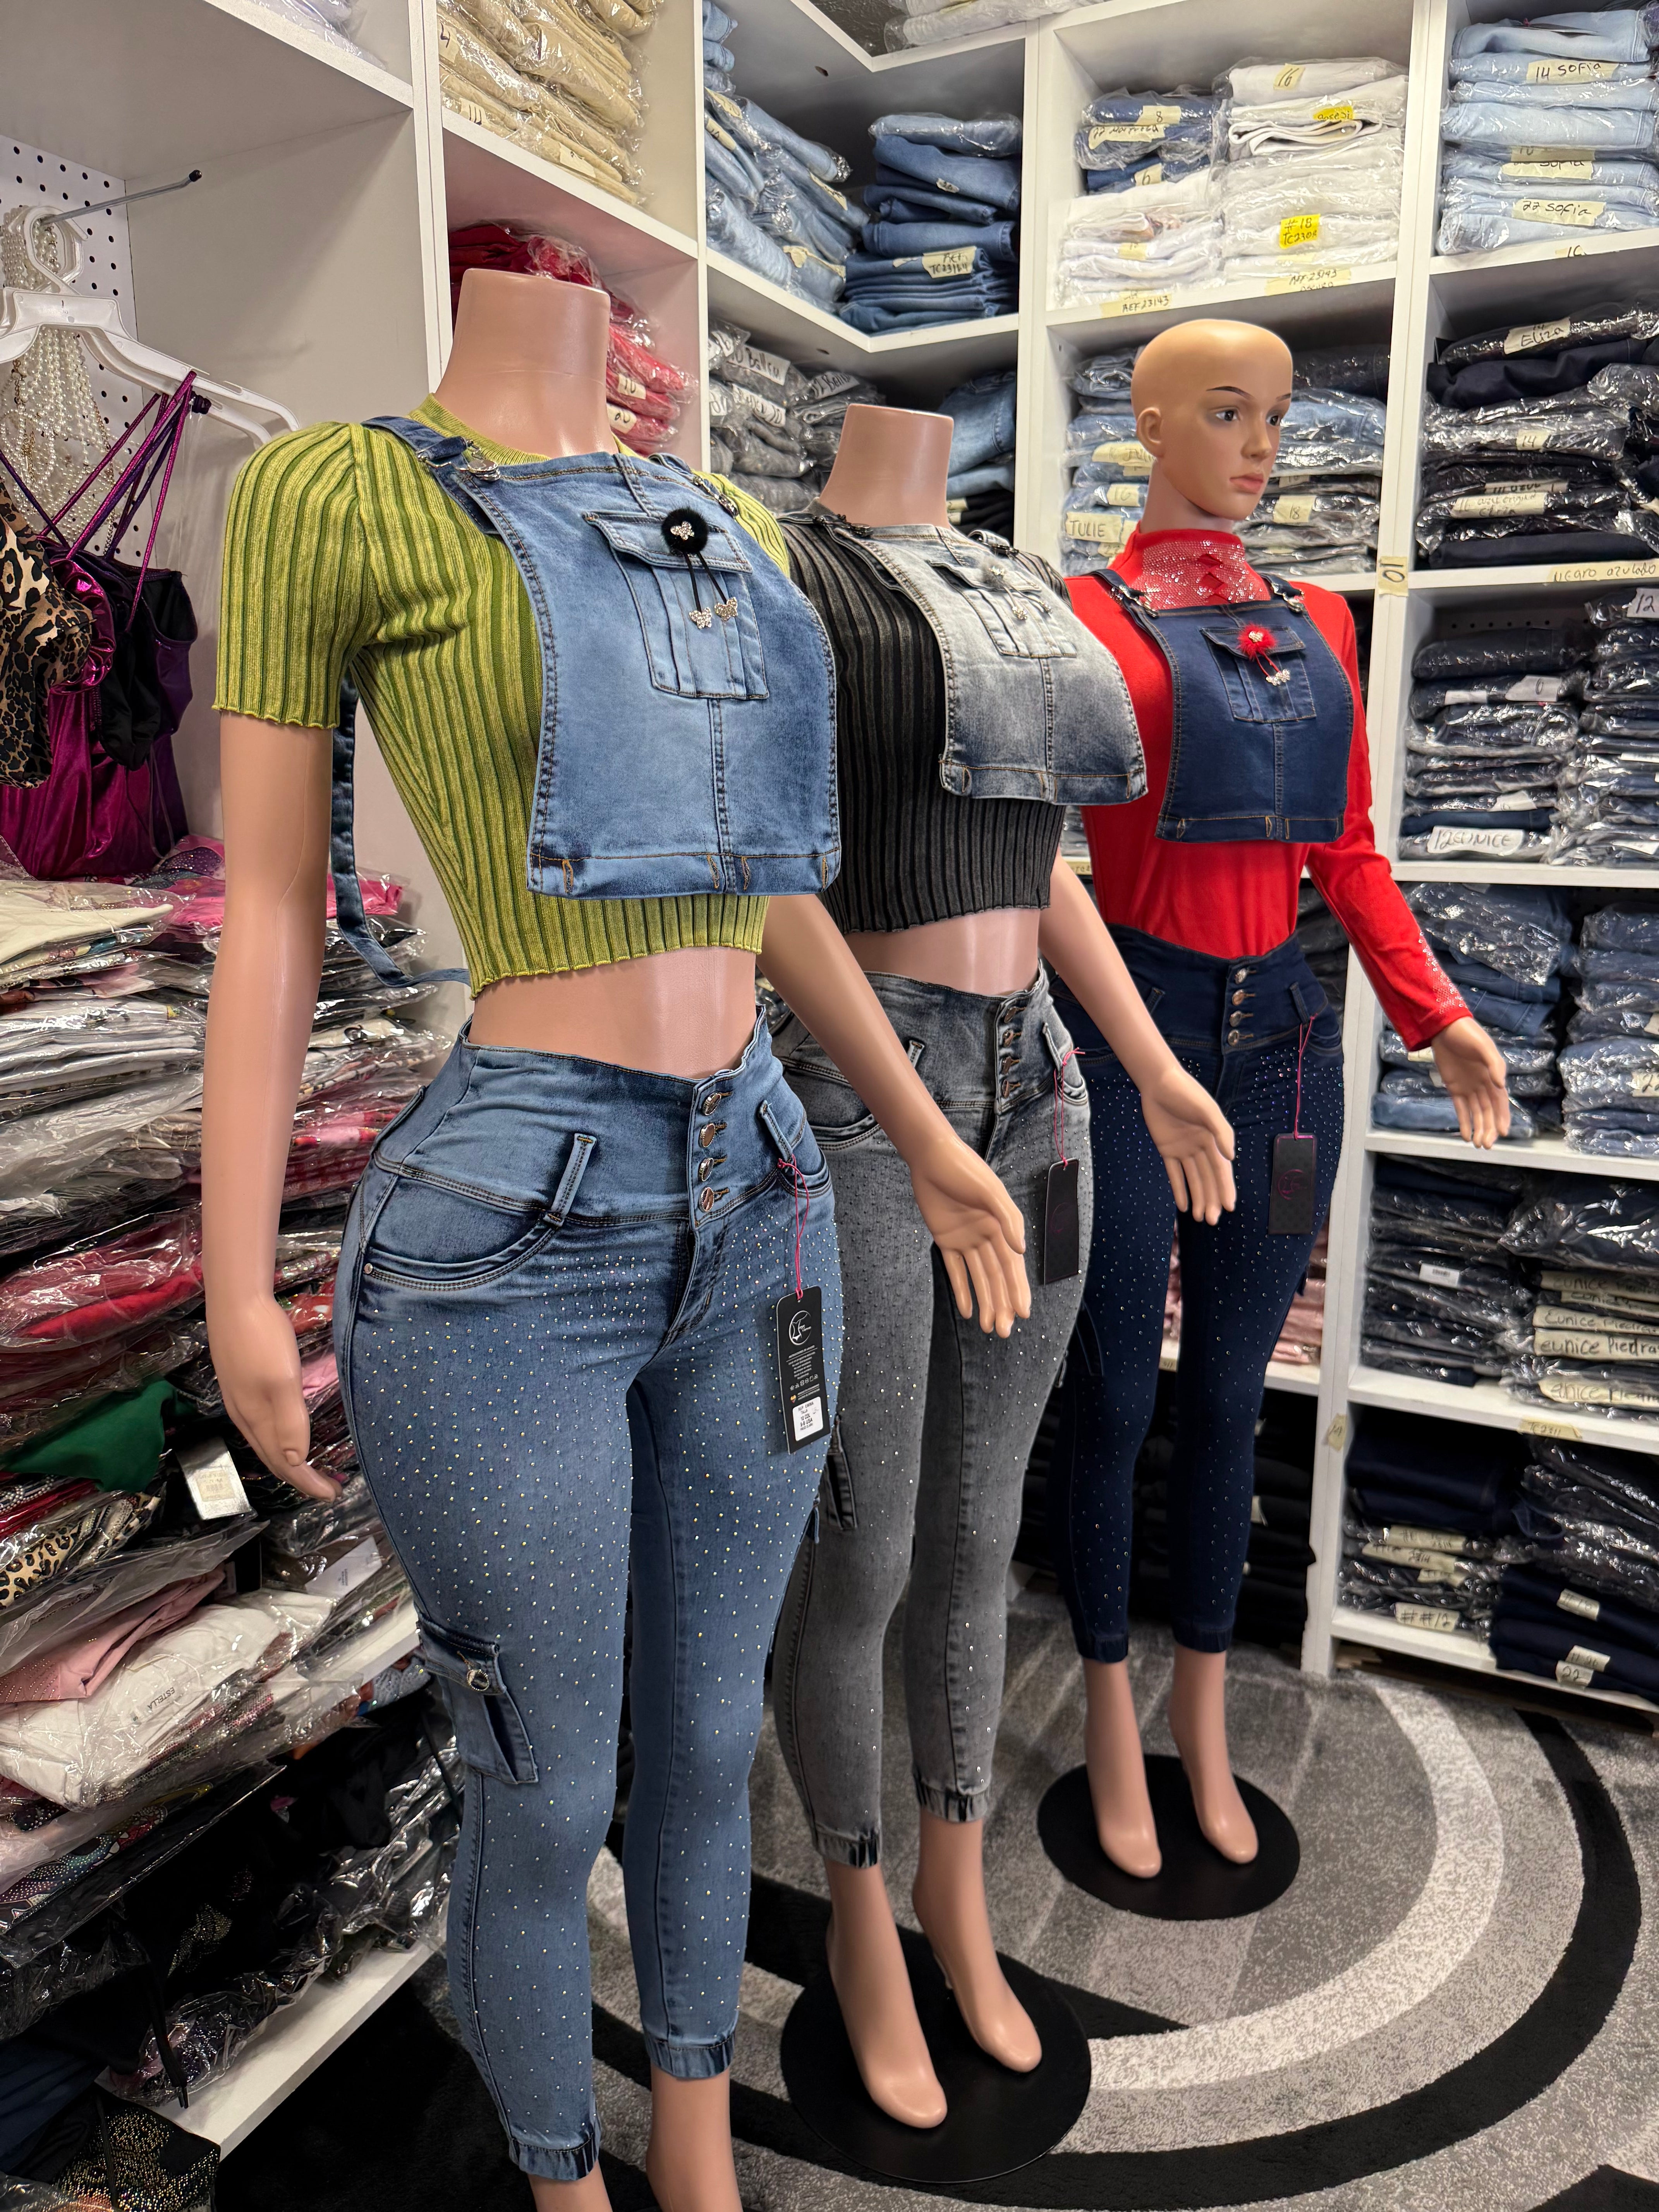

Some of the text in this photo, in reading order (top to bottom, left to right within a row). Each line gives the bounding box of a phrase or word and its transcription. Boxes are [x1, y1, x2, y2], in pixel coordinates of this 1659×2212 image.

[1278, 68, 1299, 86] 16
[1536, 67, 1550, 82] 14
[1156, 111, 1163, 122] 8
[1523, 201, 1540, 210] 22
[1636, 594, 1655, 614] 12
[147, 1687, 175, 1709] ESTELLA
